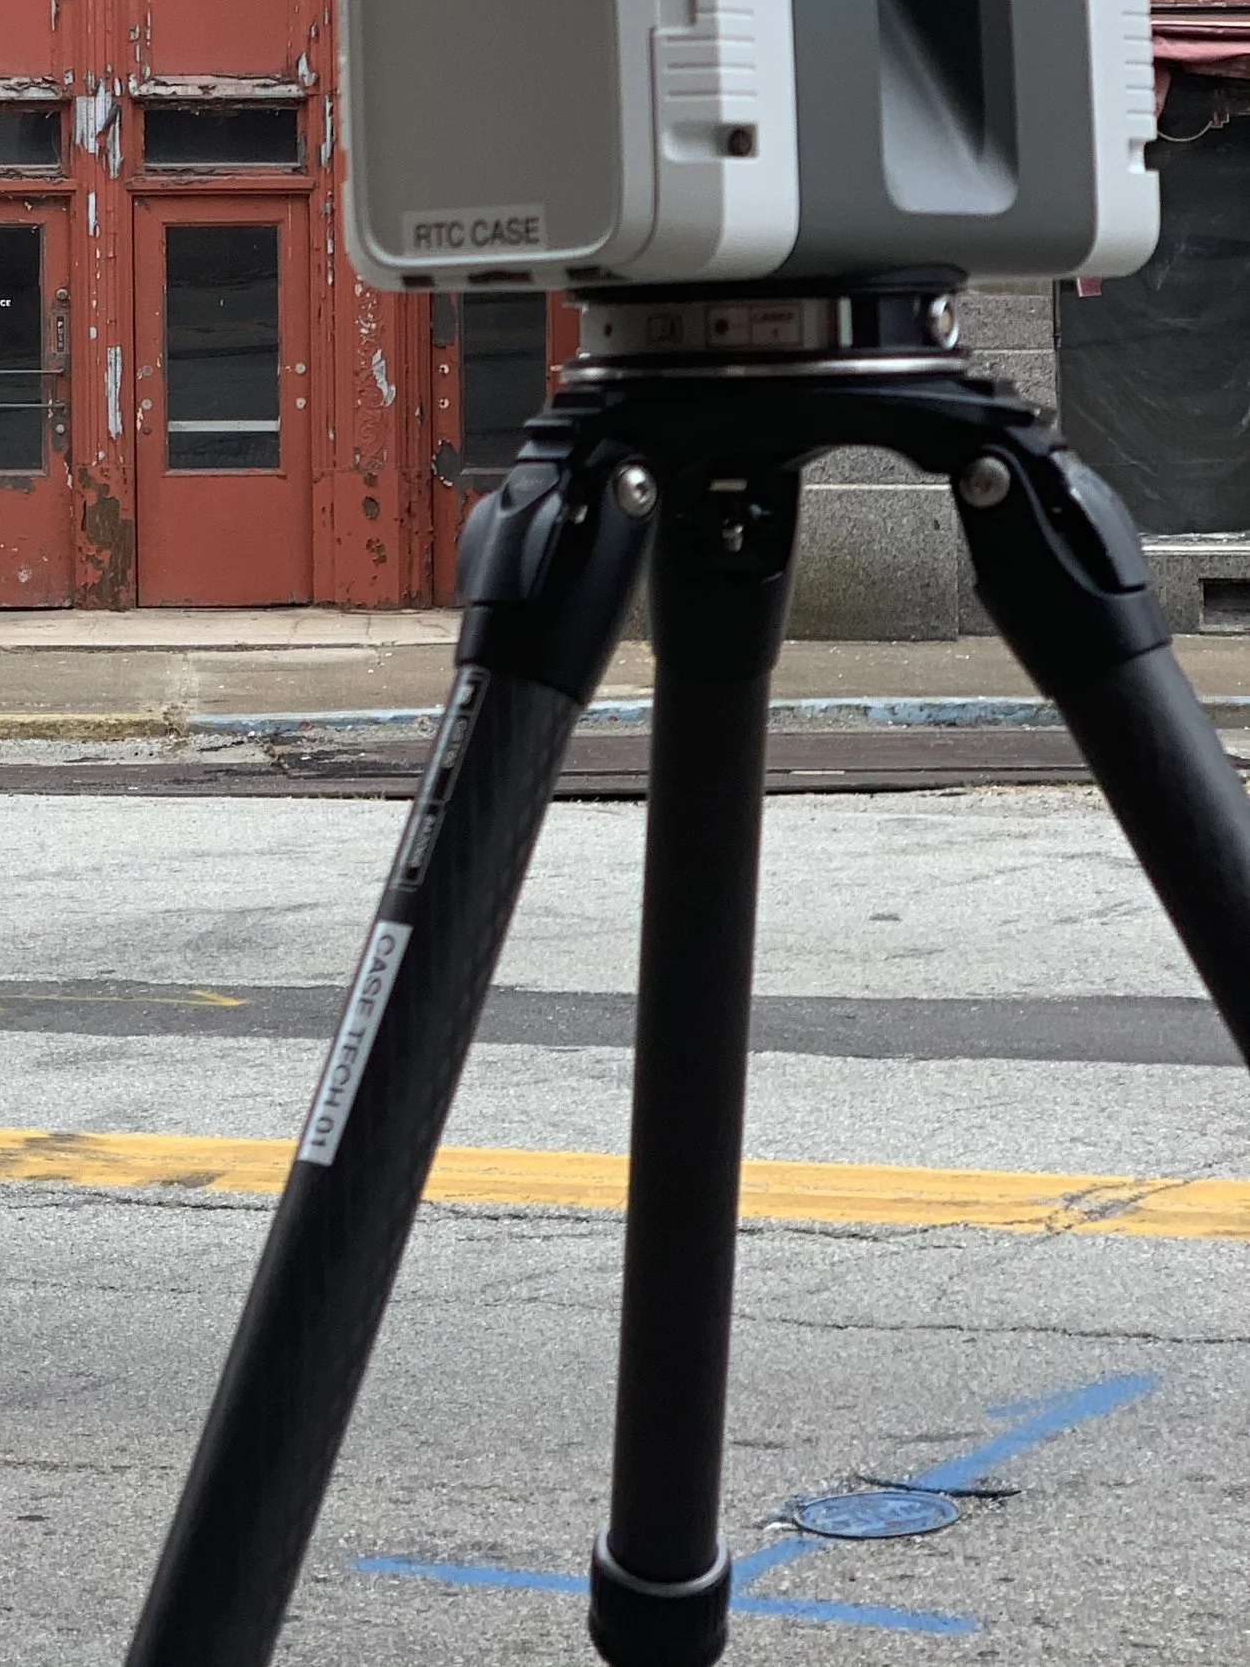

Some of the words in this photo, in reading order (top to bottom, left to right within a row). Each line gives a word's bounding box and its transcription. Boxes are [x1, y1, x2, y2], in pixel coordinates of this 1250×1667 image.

[413, 220, 465, 249] RTC
[469, 216, 540, 248] CASE
[356, 934, 396, 1018] CASE
[324, 1026, 368, 1108] TECH
